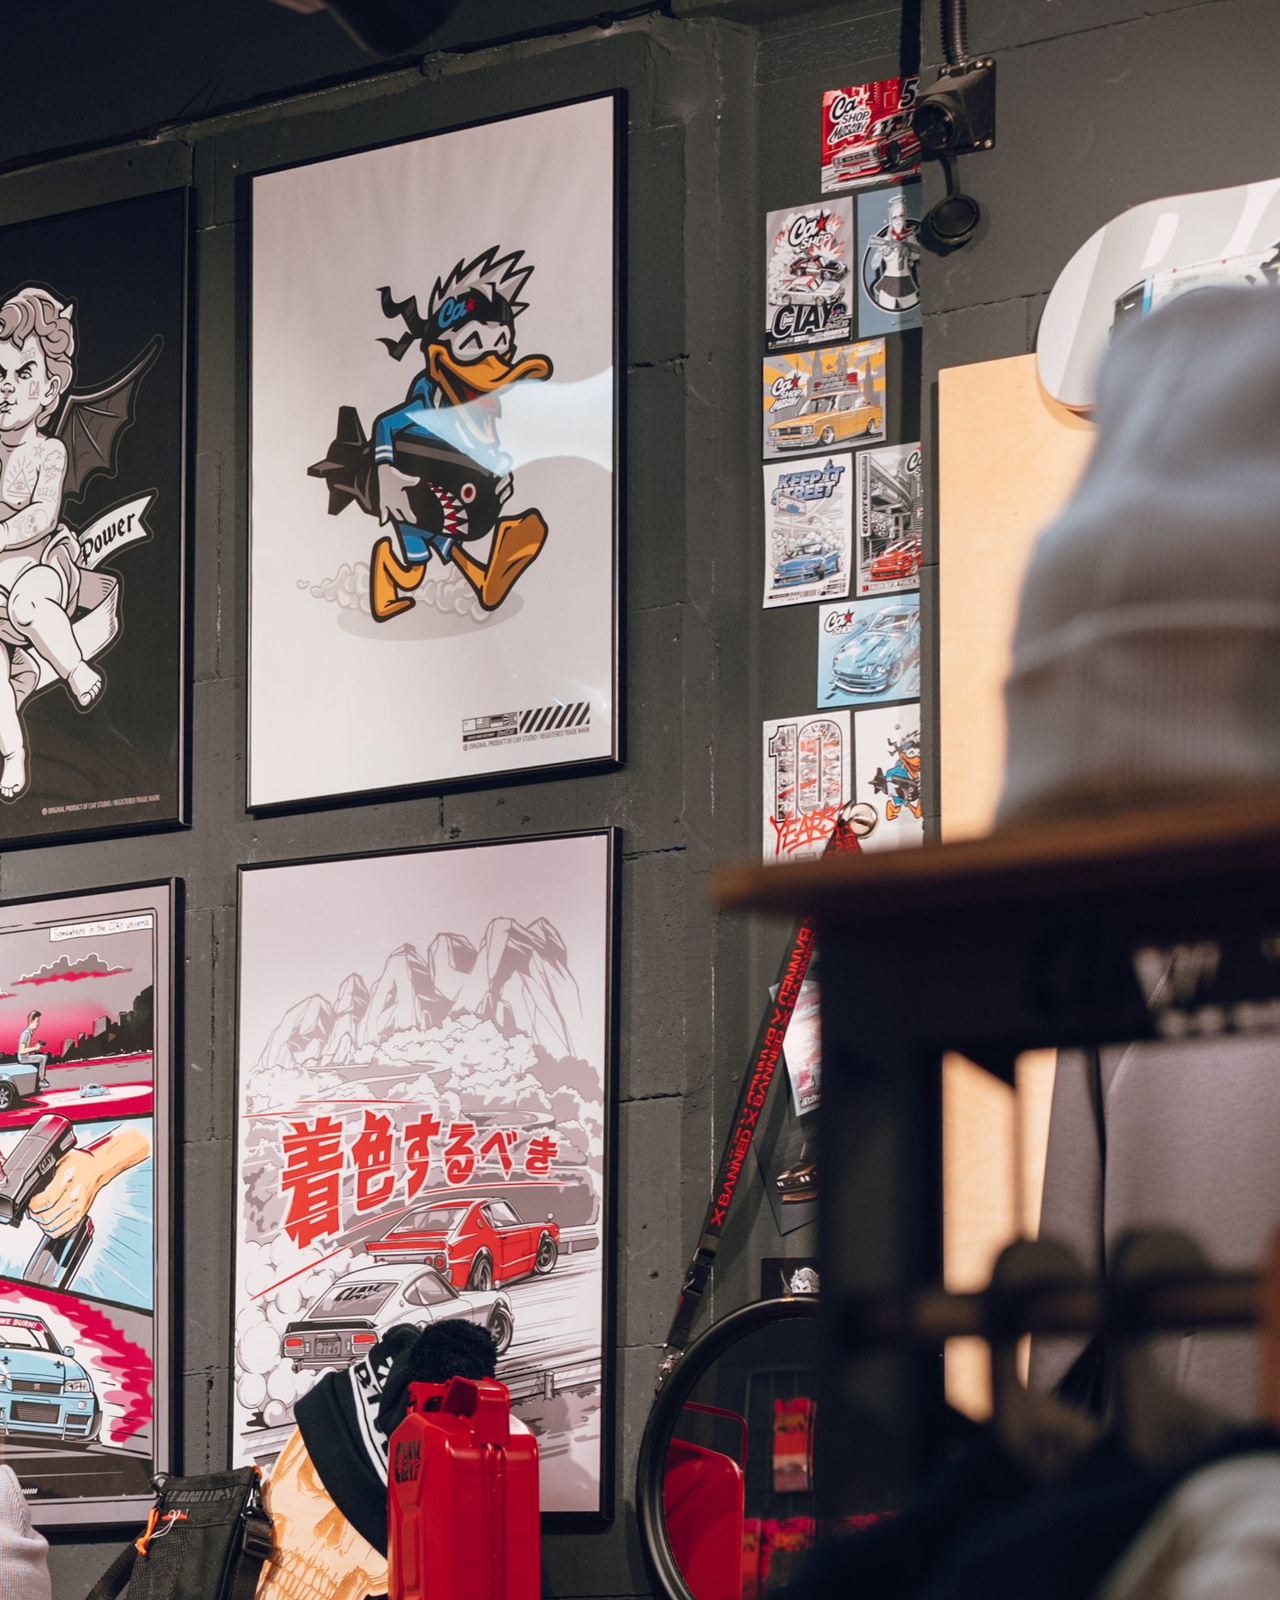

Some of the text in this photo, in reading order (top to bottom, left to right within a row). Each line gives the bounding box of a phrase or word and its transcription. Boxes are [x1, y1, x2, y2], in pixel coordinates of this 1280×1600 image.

[841, 111, 871, 124] SHOP
[800, 232, 831, 250] SHOP
[777, 470, 820, 488] KEEP
[820, 459, 846, 483] IT
[469, 741, 487, 750] ORIGINAL
[488, 738, 506, 747] PRODUCT
[521, 733, 538, 742] STUDIO
[540, 730, 565, 740] REGISTERED
[565, 728, 577, 737] TRADE
[769, 719, 842, 823] 10
[718, 1128, 753, 1207] BANNED
[753, 1029, 784, 1107] BANNED
[280, 1109, 559, 1250] 着色するべき
[0, 1317, 11, 1327] WE
[12, 1319, 38, 1330] BURN!
